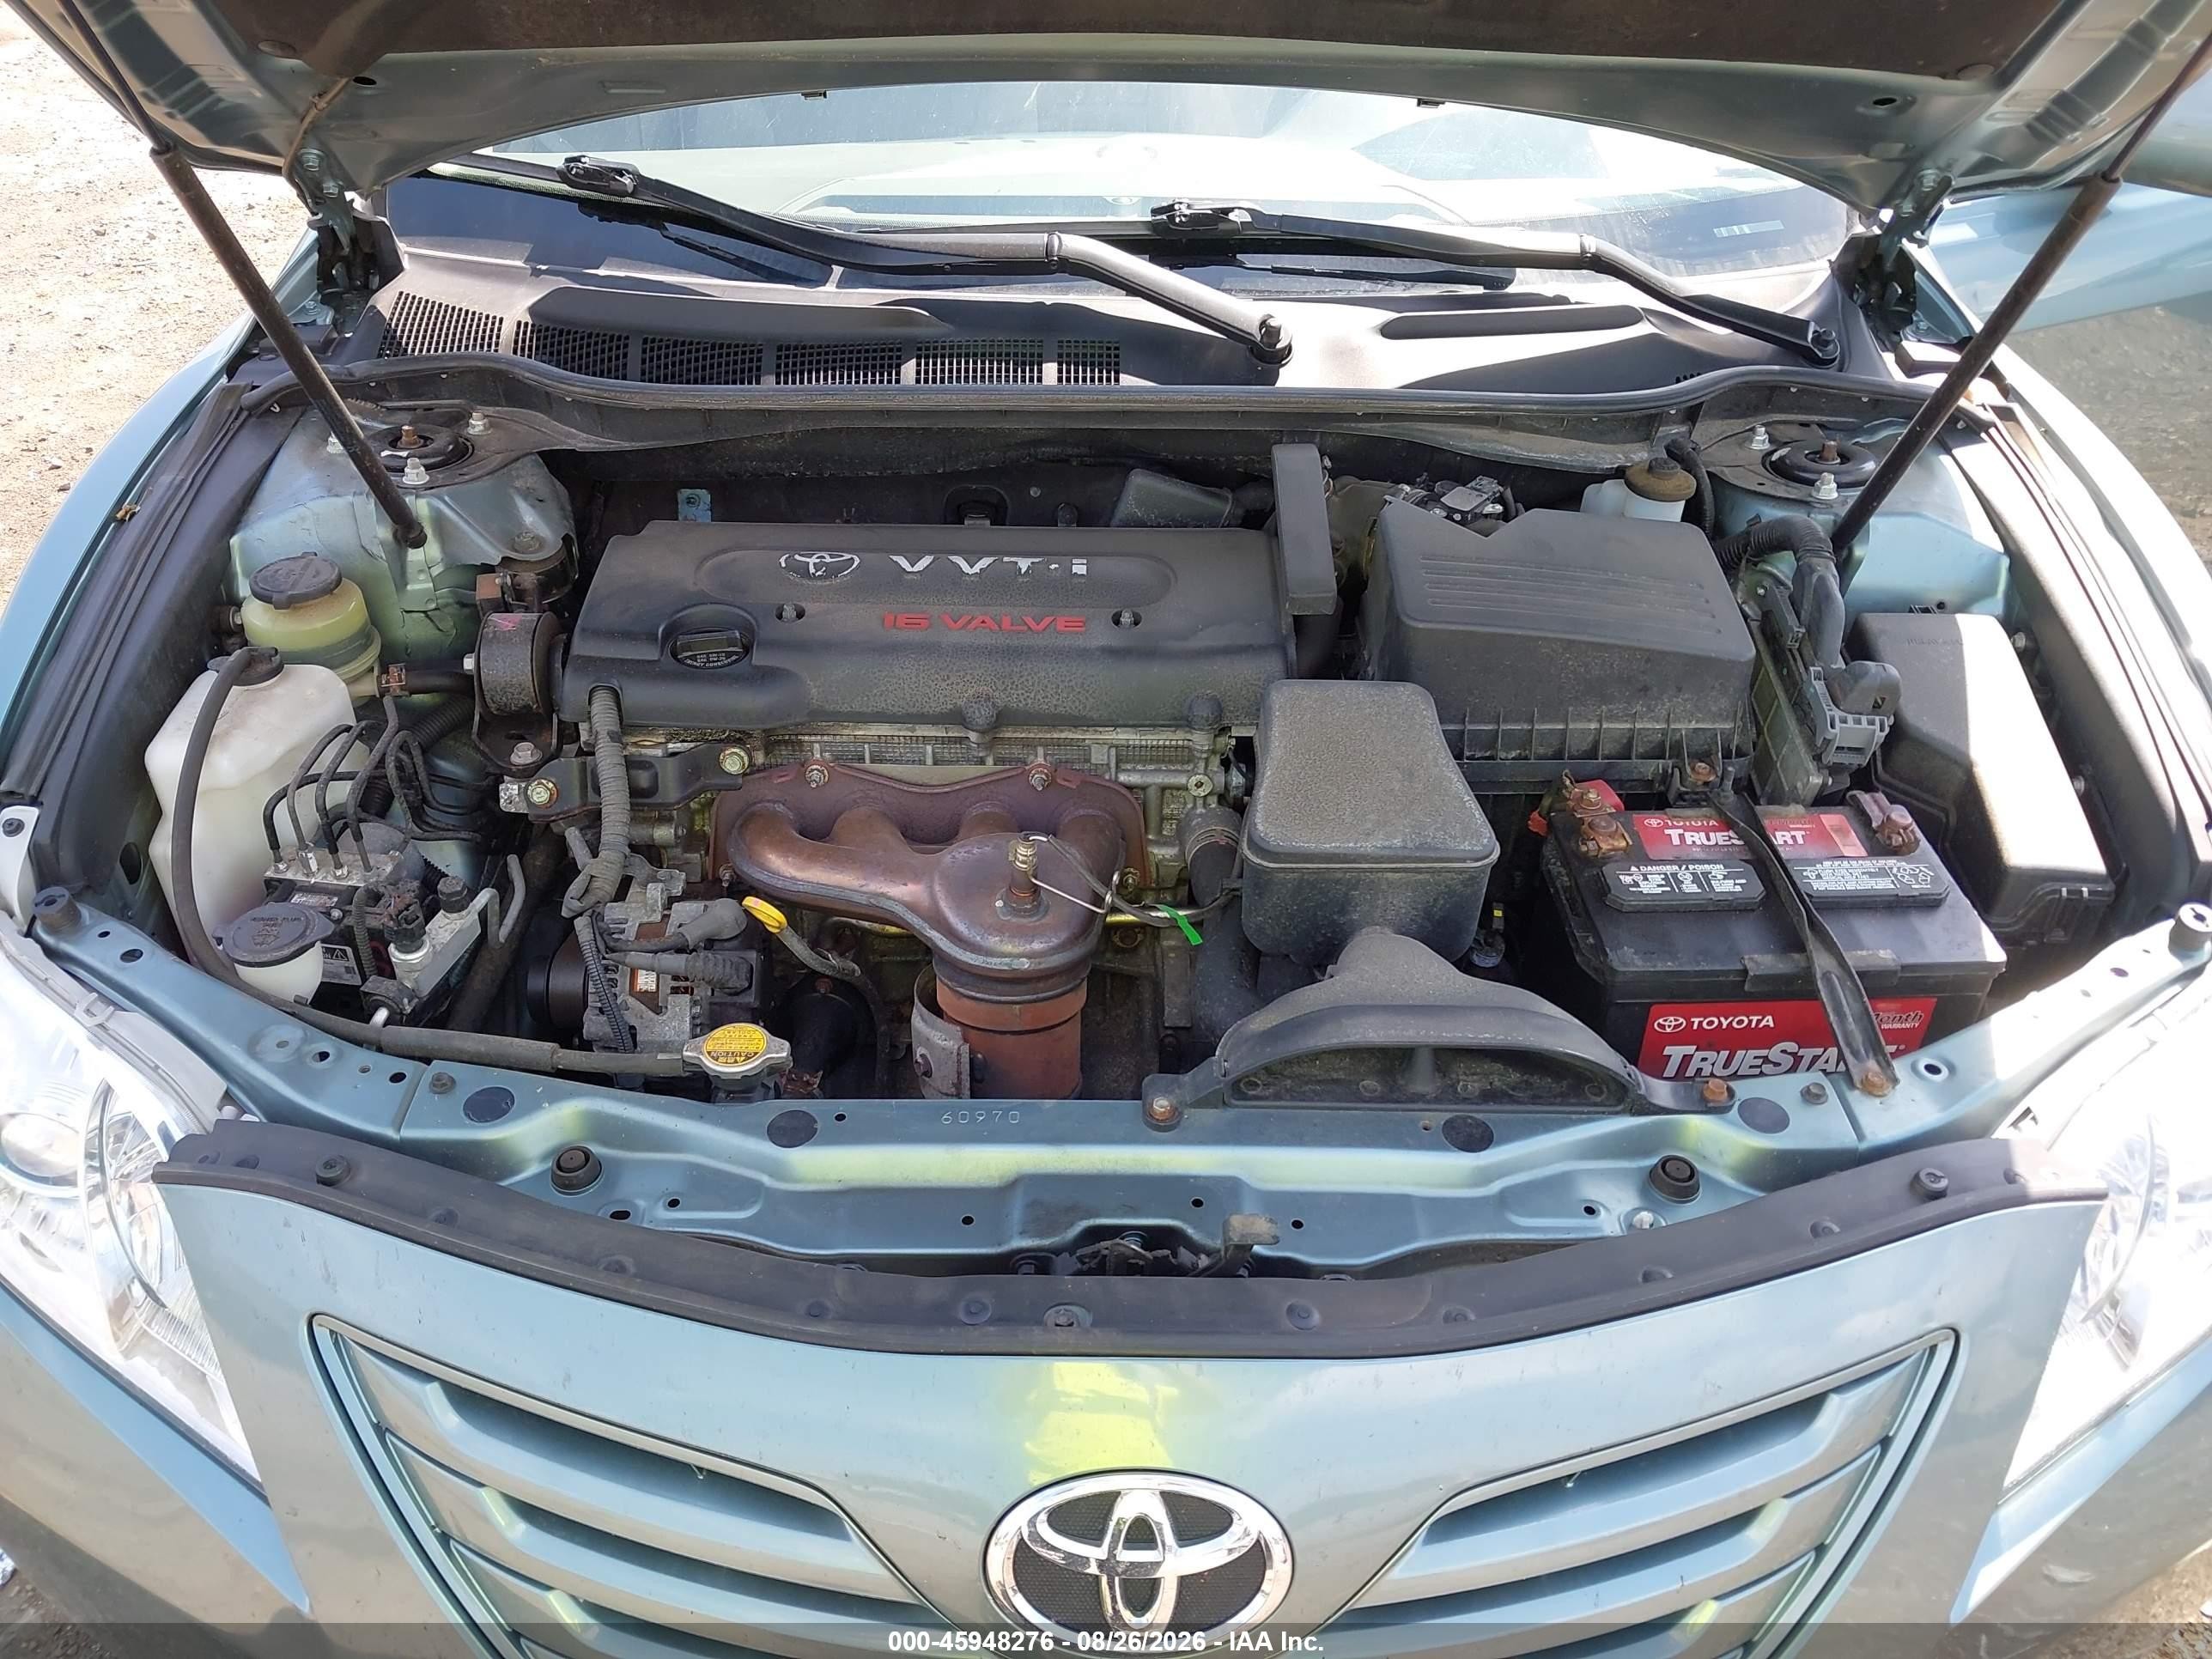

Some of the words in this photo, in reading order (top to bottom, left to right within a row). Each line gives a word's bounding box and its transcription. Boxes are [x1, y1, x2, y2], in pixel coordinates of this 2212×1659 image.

[883, 611, 930, 630] 16
[939, 612, 1086, 633] VALVE
[1690, 1015, 1775, 1030] TOYOTA
[941, 1110, 1020, 1124] 60970
